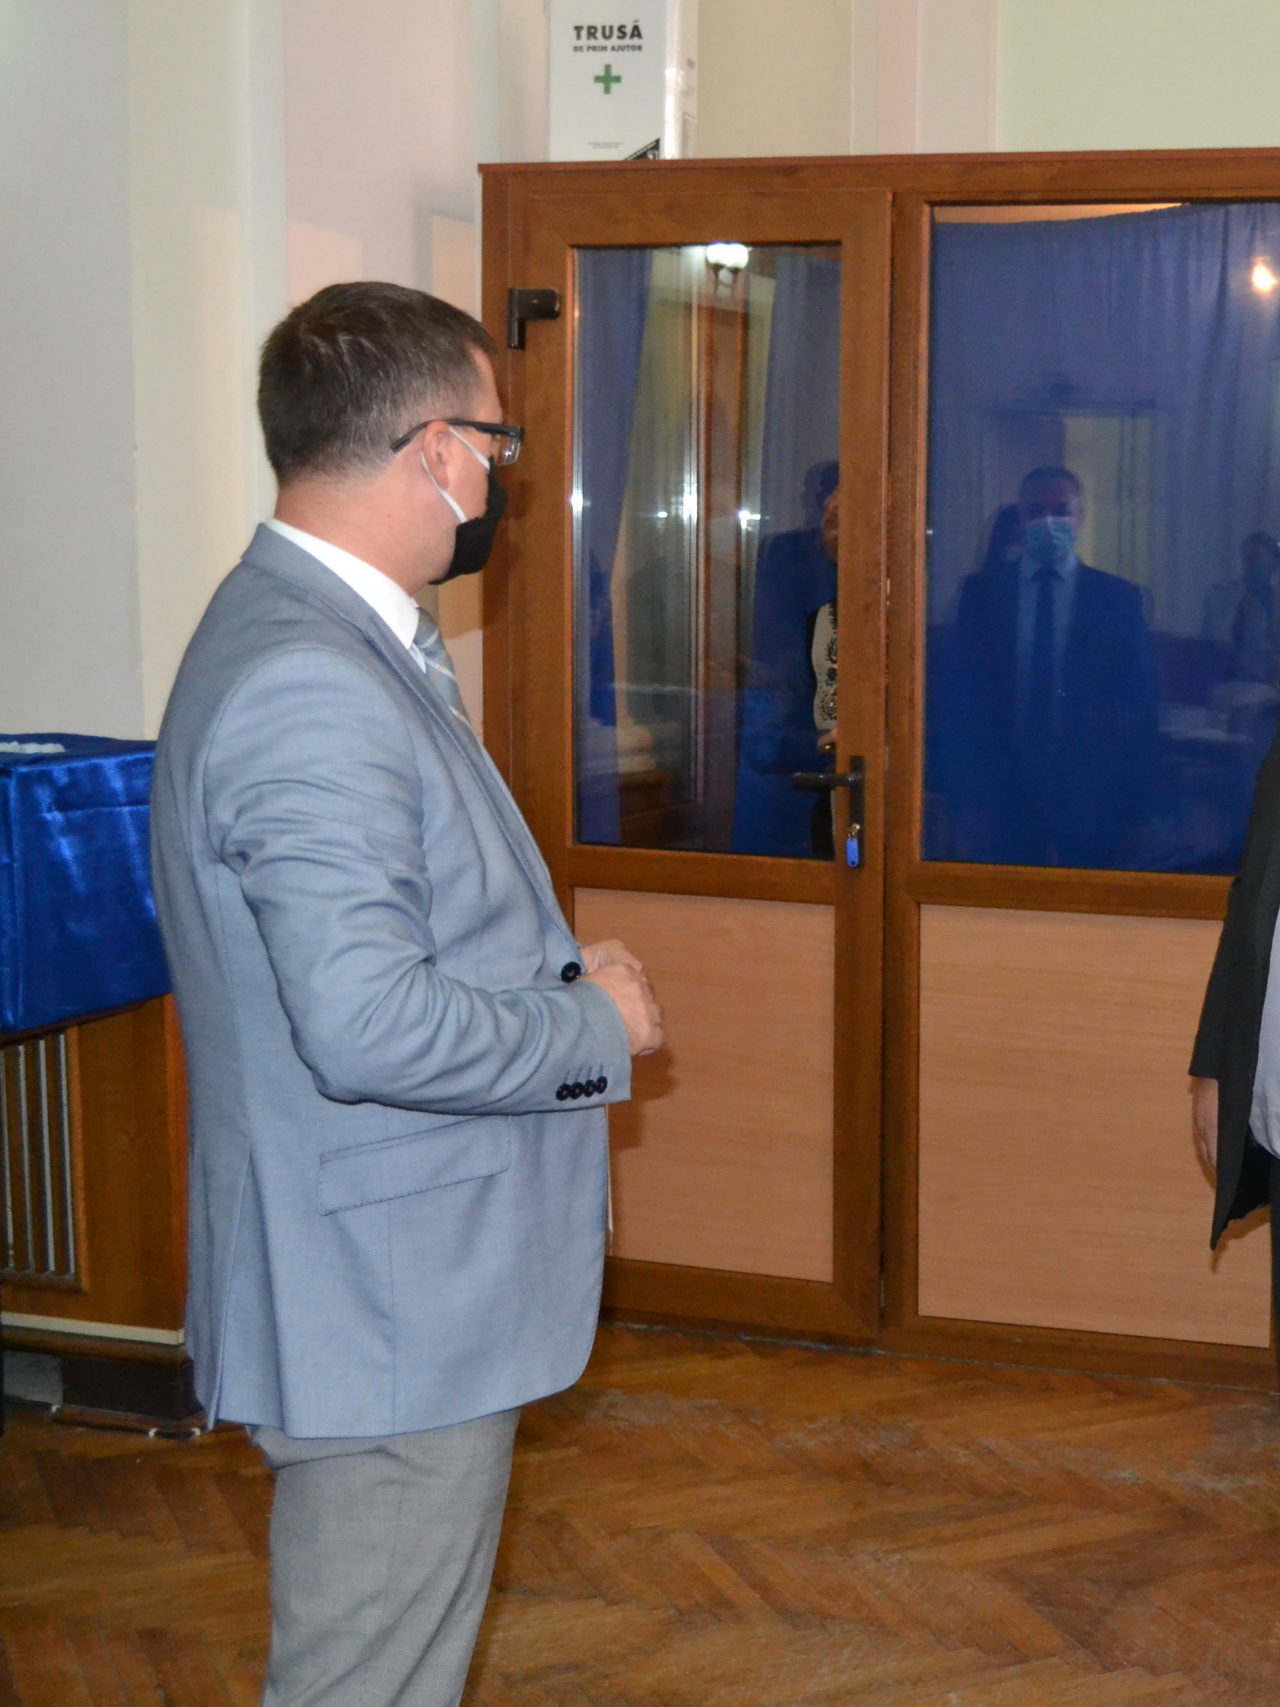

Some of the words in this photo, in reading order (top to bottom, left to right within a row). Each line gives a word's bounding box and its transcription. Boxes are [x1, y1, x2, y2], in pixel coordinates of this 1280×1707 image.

[573, 45, 584, 53] DE
[586, 45, 608, 53] PRIM
[610, 44, 643, 52] AJUTOR
